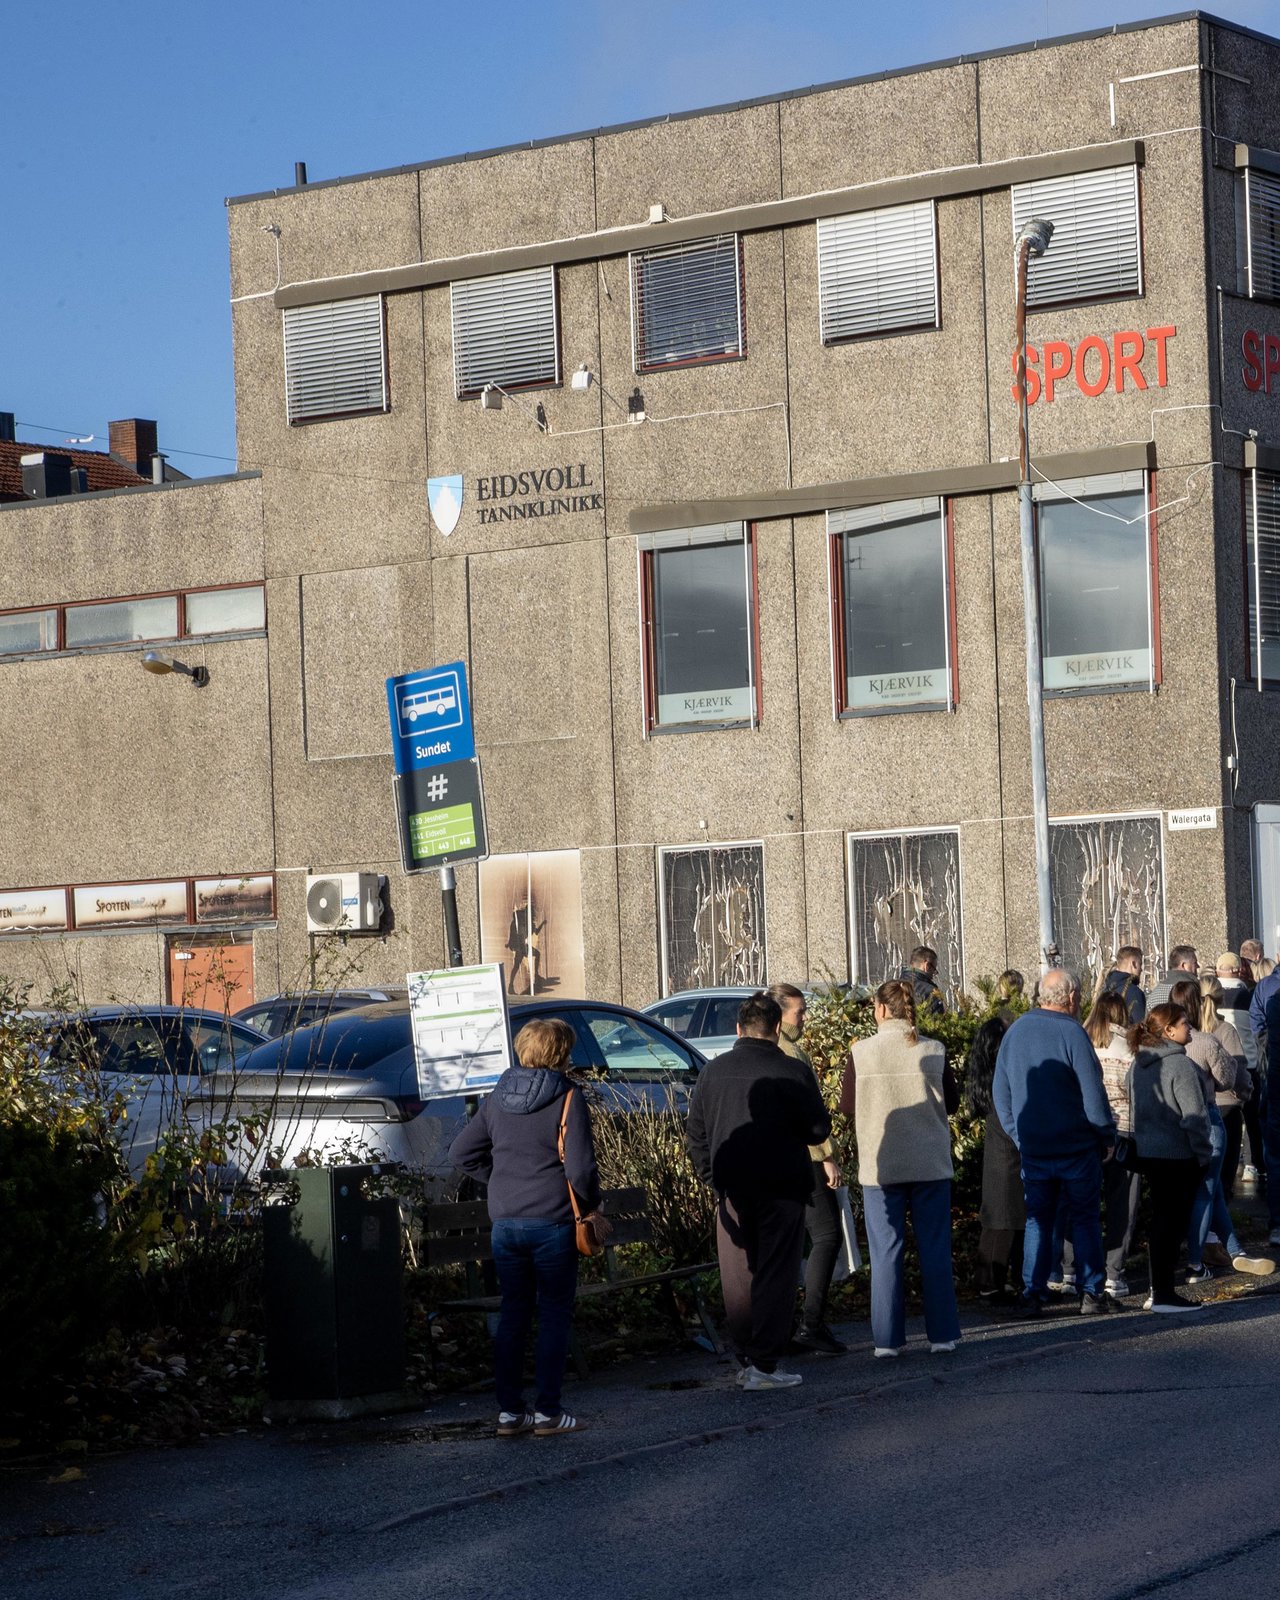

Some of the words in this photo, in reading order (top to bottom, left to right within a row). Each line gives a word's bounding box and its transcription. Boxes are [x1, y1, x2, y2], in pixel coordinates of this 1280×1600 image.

[1011, 325, 1176, 407] SPORT
[476, 464, 593, 500] EIDSVOLL
[476, 494, 605, 524] TANNKLINIKK
[1066, 656, 1134, 677] KJÆRVIK
[869, 675, 933, 694] KJÆRVIK
[684, 696, 733, 711] KJÆRVIK
[416, 741, 451, 759] Sundet
[96, 899, 130, 914] SPORTEN
